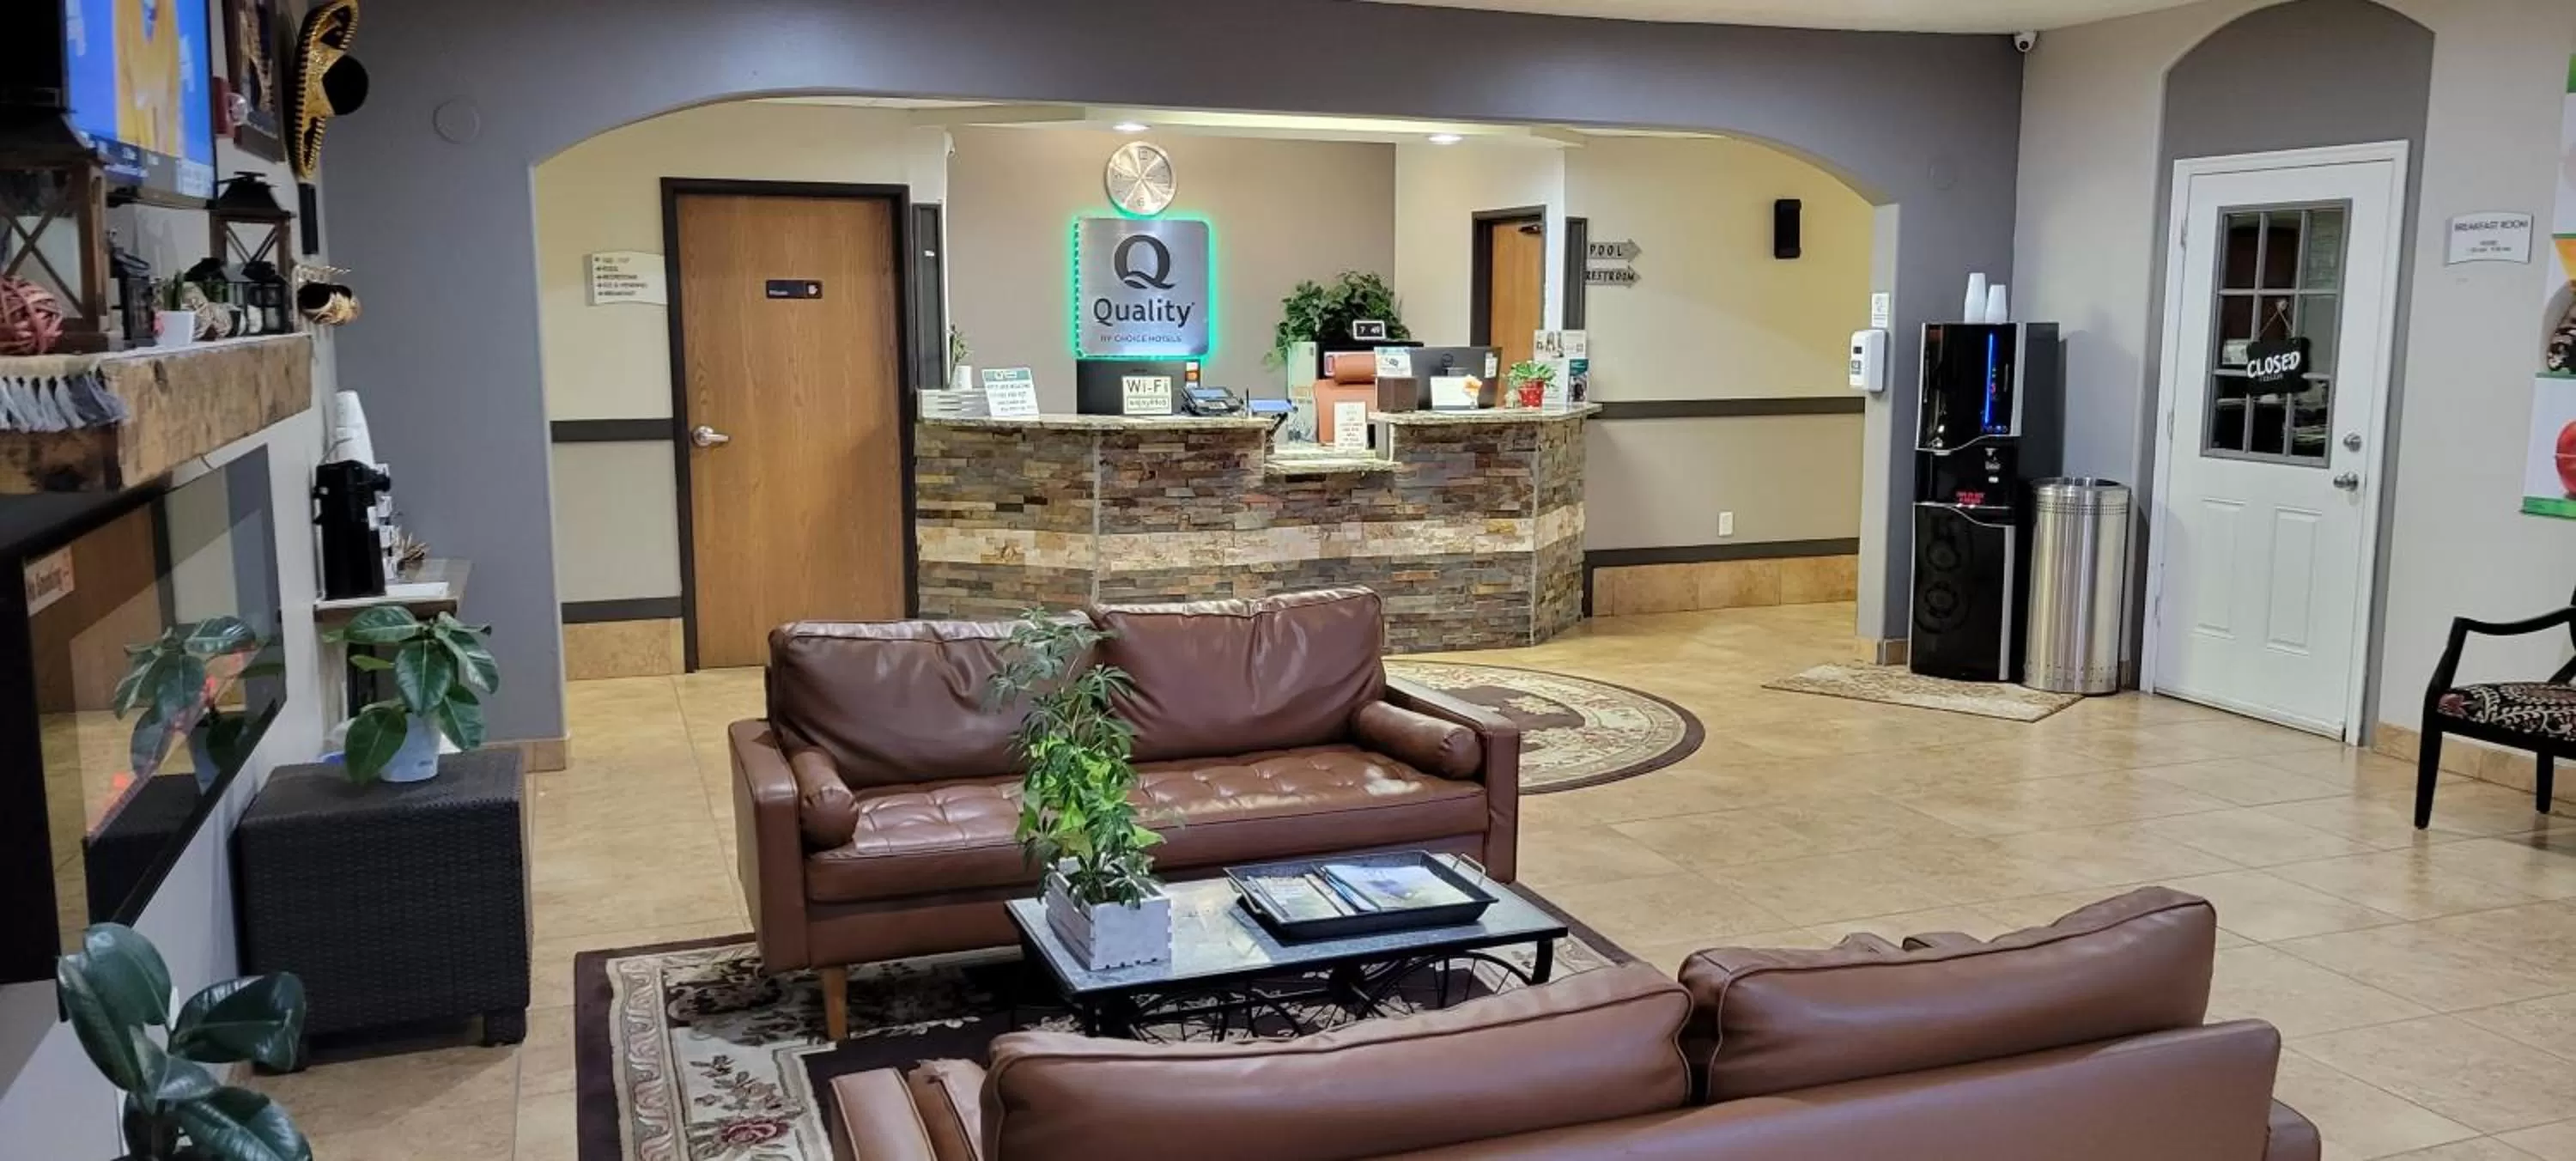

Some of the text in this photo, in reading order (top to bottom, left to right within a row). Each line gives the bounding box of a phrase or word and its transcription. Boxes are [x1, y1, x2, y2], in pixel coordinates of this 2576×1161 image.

[2500, 219, 2529, 228] ROOM
[1589, 244, 1622, 257] POOL
[1115, 234, 1176, 289] Q
[1585, 270, 1635, 282] RESTROOM
[1093, 297, 1192, 328] Quality
[1115, 334, 1145, 343] CHOICE
[1148, 334, 1182, 343] HOTELS
[2246, 350, 2301, 379] CLOSED
[1126, 379, 1169, 394] Wi-Fi
